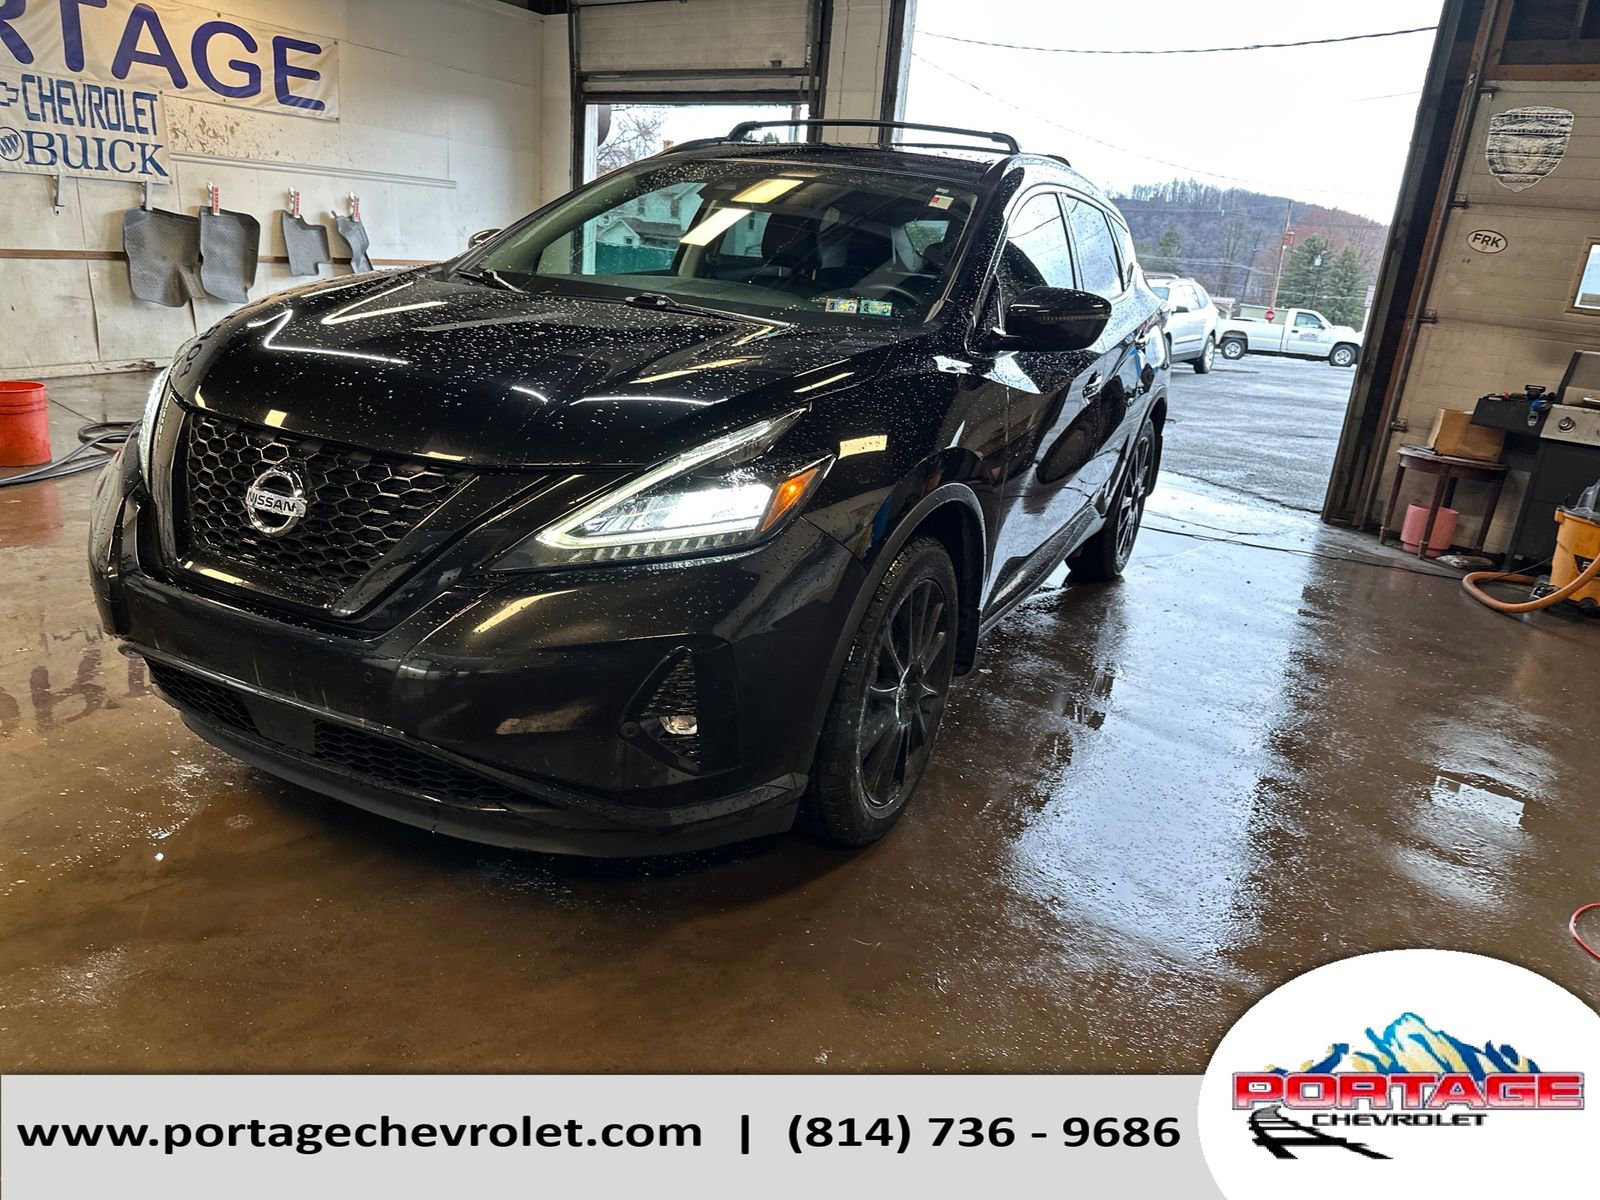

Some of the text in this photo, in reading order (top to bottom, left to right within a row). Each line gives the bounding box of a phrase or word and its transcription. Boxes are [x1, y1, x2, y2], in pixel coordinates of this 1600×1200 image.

[21, 73, 158, 136] CHEVROLET
[20, 129, 170, 177] BUICK
[1472, 232, 1502, 248] FRK
[248, 489, 296, 512] NISSAN
